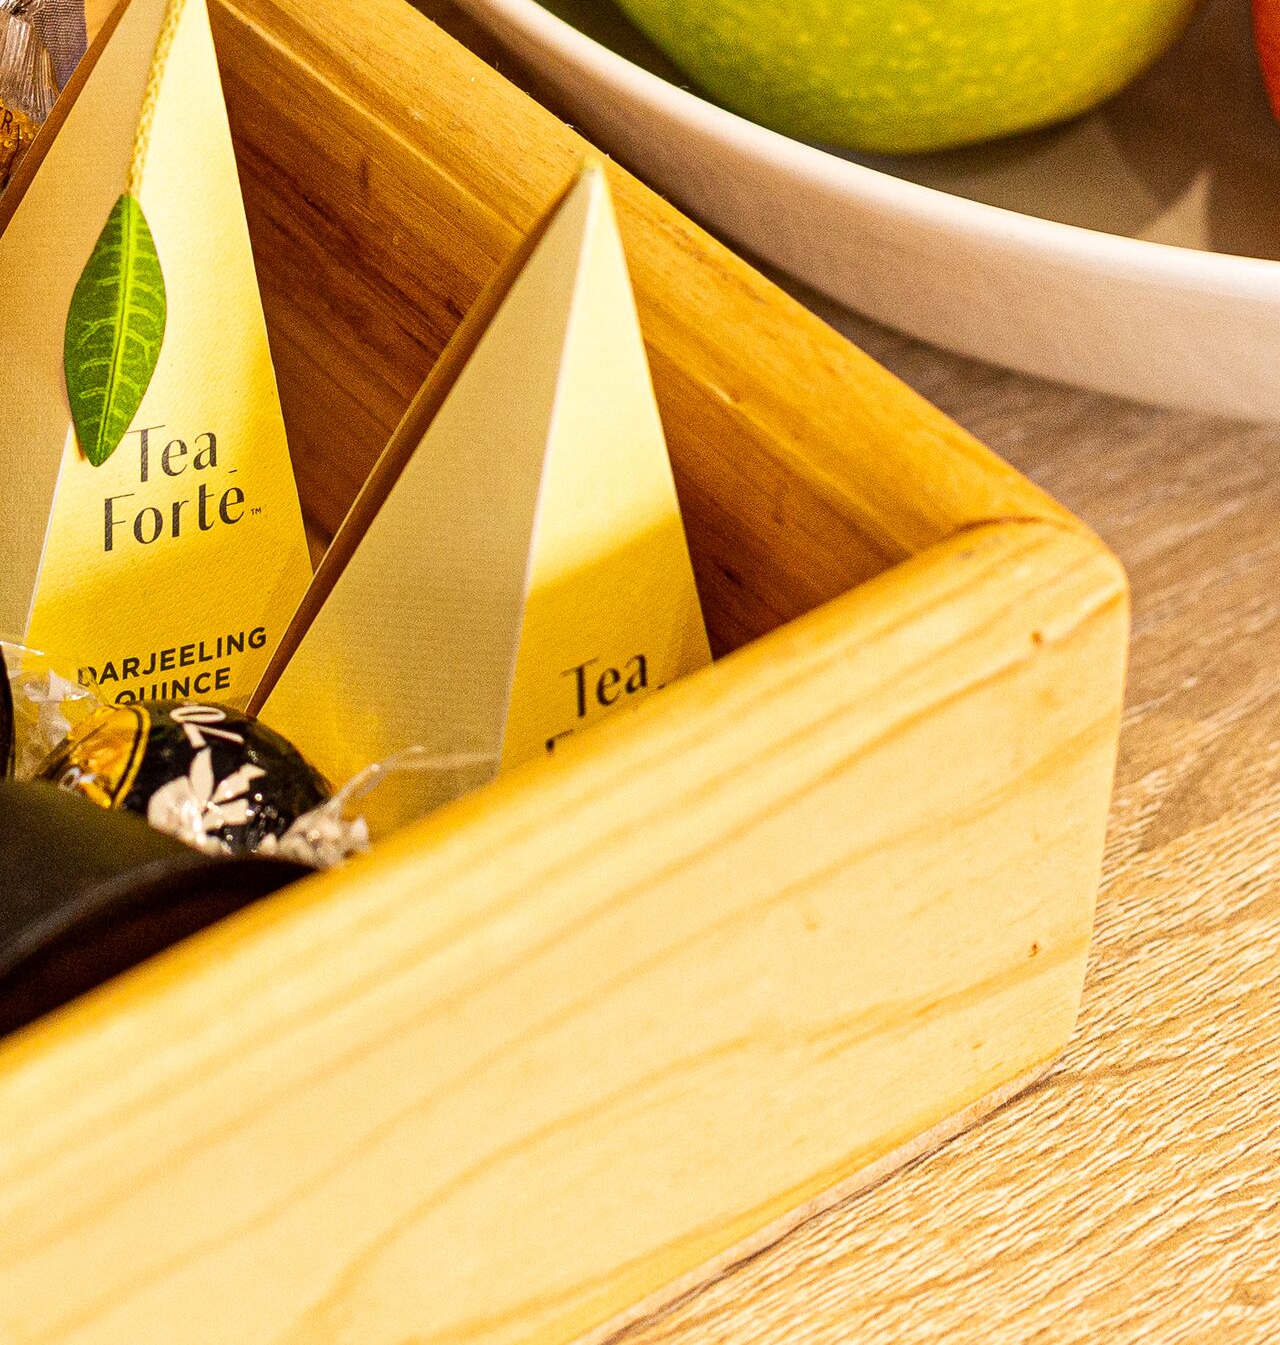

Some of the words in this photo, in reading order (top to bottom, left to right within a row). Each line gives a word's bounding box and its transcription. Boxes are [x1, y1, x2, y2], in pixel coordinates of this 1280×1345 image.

[124, 424, 218, 483] Tea
[77, 625, 267, 686] DARJEELING
[560, 654, 648, 718] Tea
